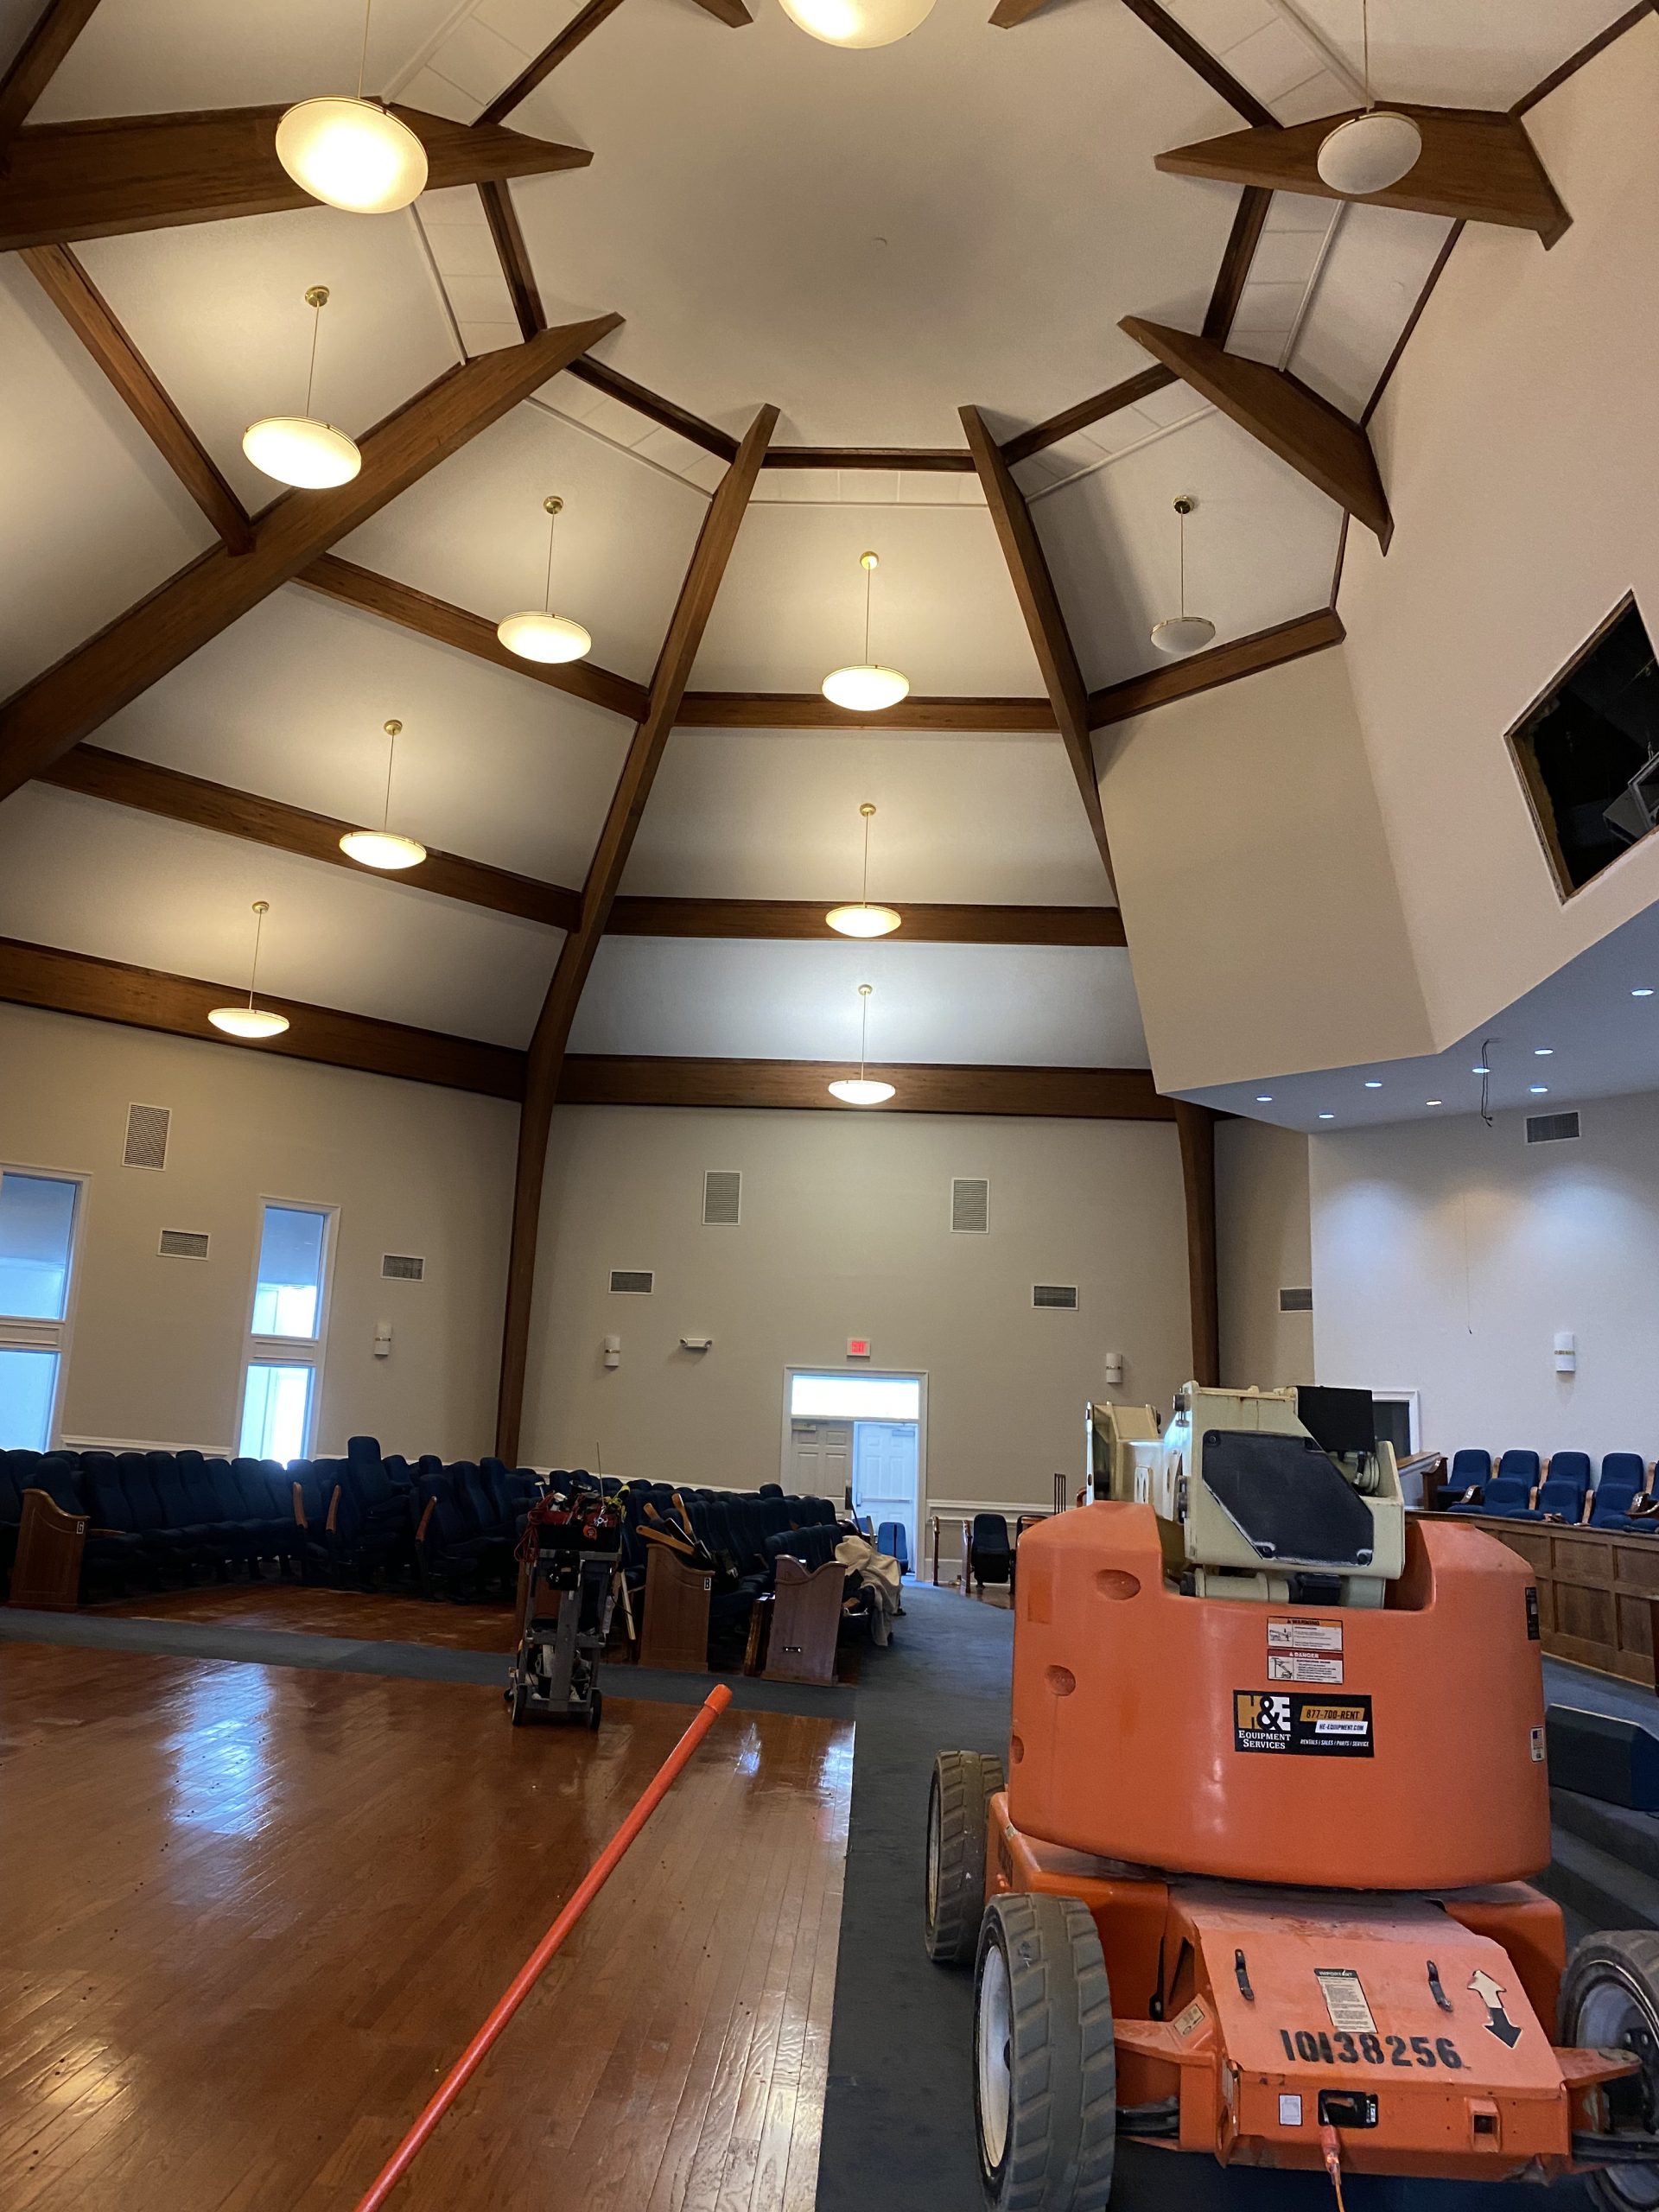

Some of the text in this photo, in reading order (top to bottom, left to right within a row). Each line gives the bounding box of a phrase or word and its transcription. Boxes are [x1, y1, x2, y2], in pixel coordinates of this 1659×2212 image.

[1236, 1694, 1291, 1732] H&E
[1306, 1709, 1360, 1719] 877-700-RENT
[1238, 1730, 1292, 1741] EQUIPMENT
[1243, 1738, 1286, 1750] SERVICES
[1281, 2029, 1462, 2069] 10138256
